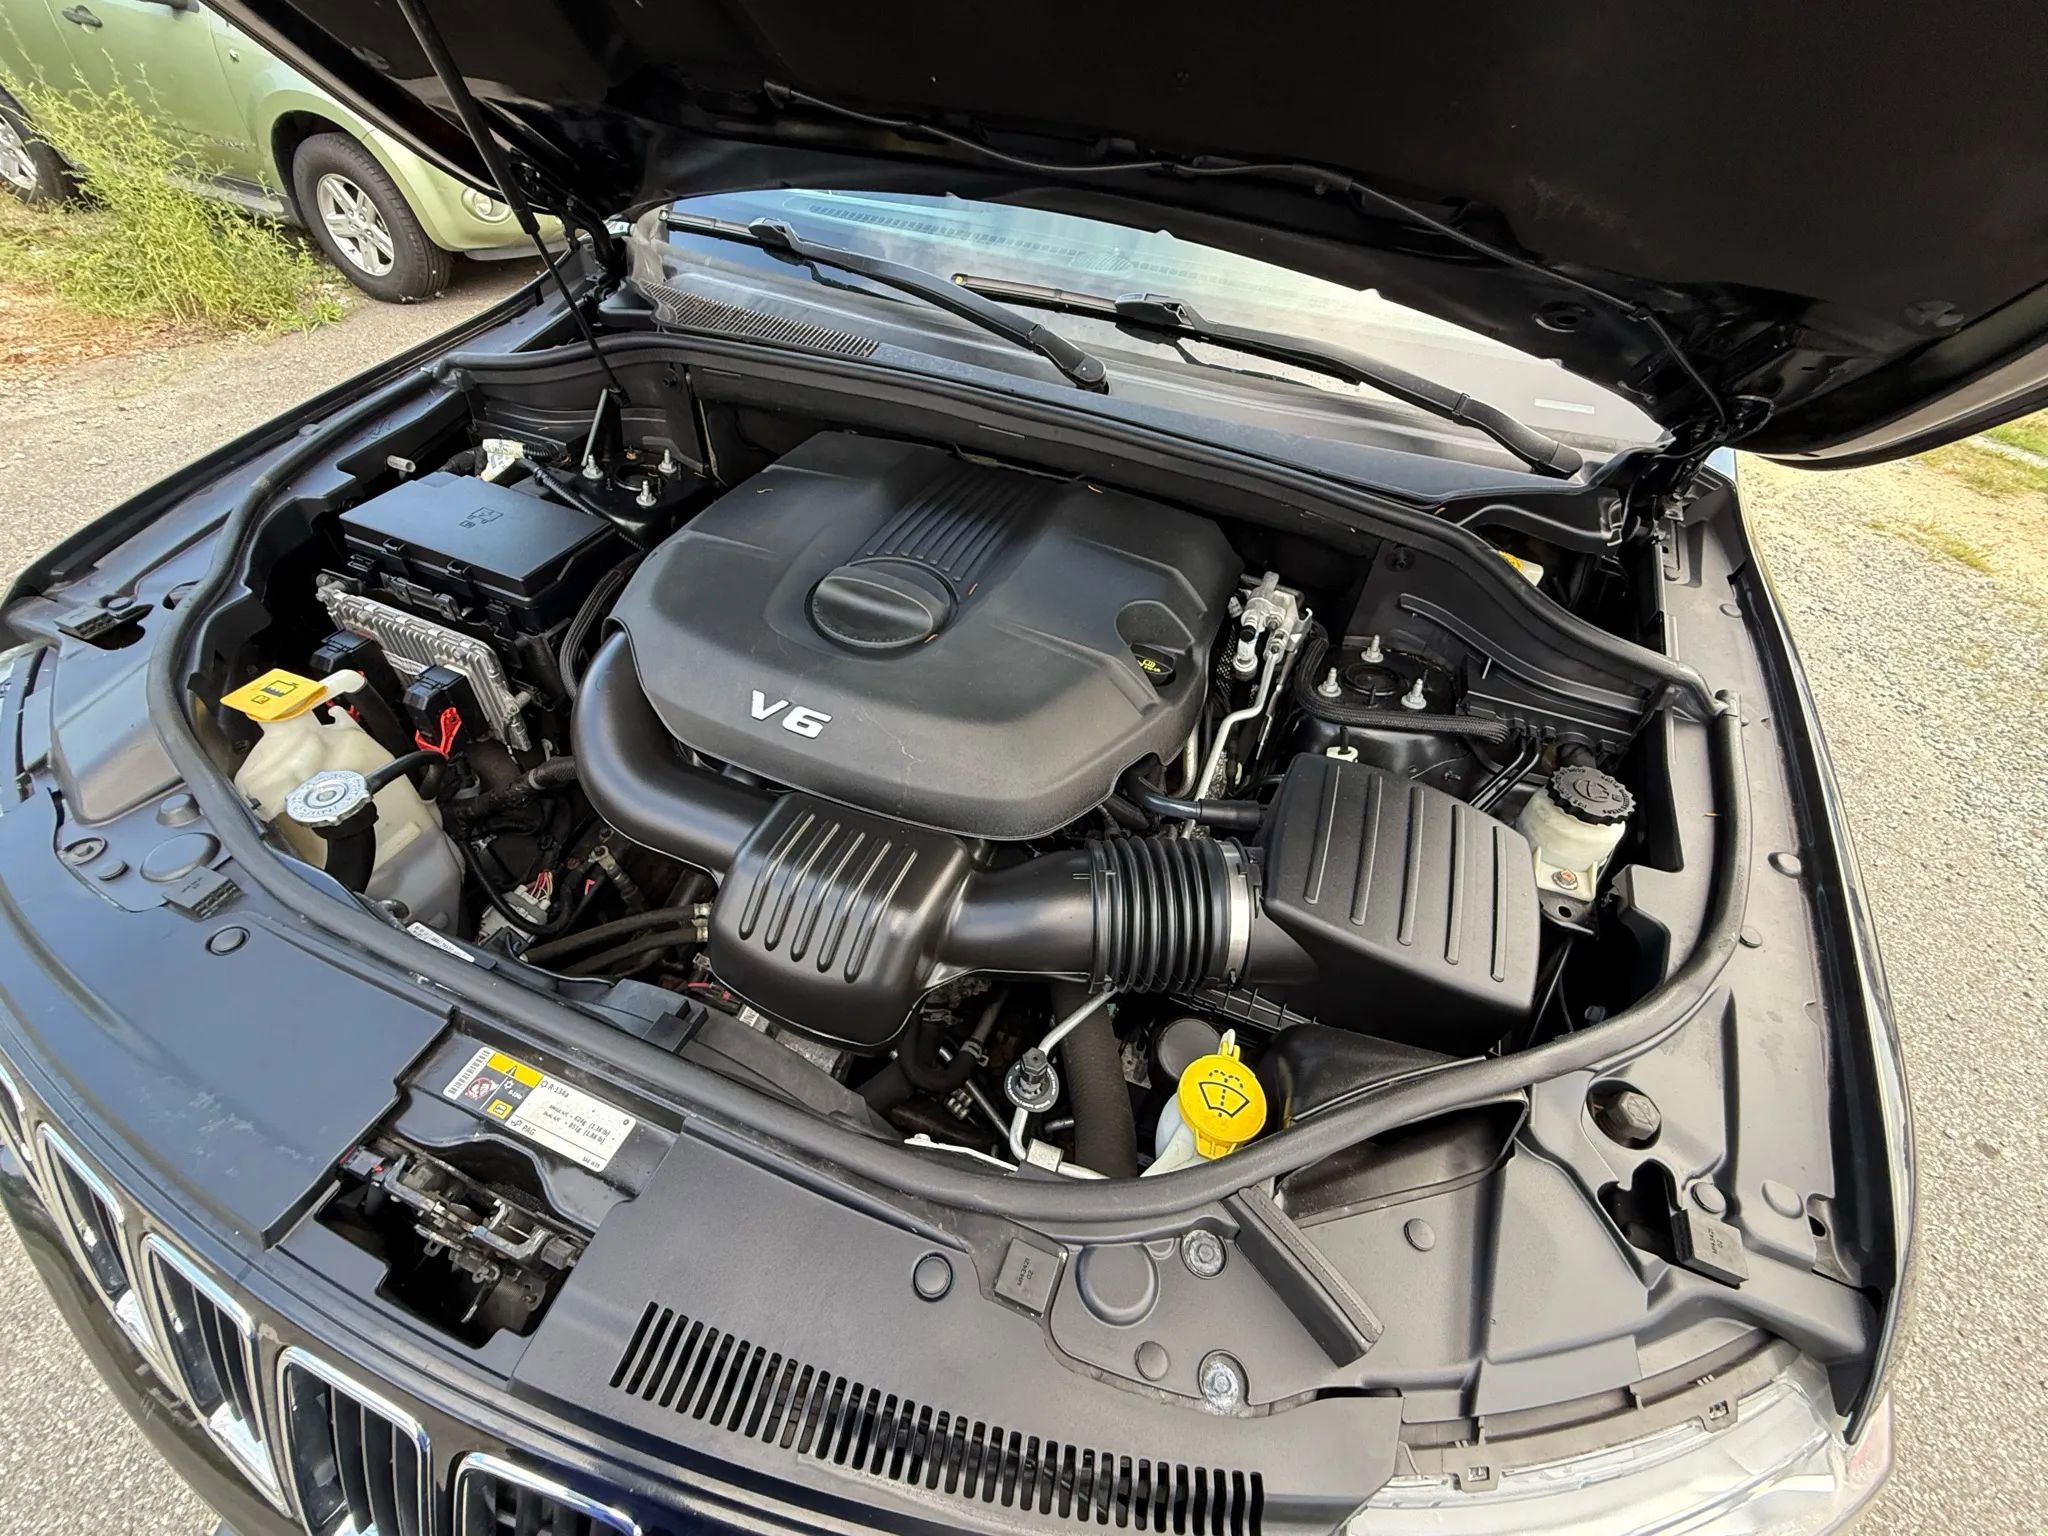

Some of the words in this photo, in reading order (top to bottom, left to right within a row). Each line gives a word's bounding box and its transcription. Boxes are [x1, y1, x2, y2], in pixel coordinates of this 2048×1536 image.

[751, 689, 833, 739] V6
[547, 1082, 570, 1099] R-134a
[521, 1124, 537, 1136] PAG
